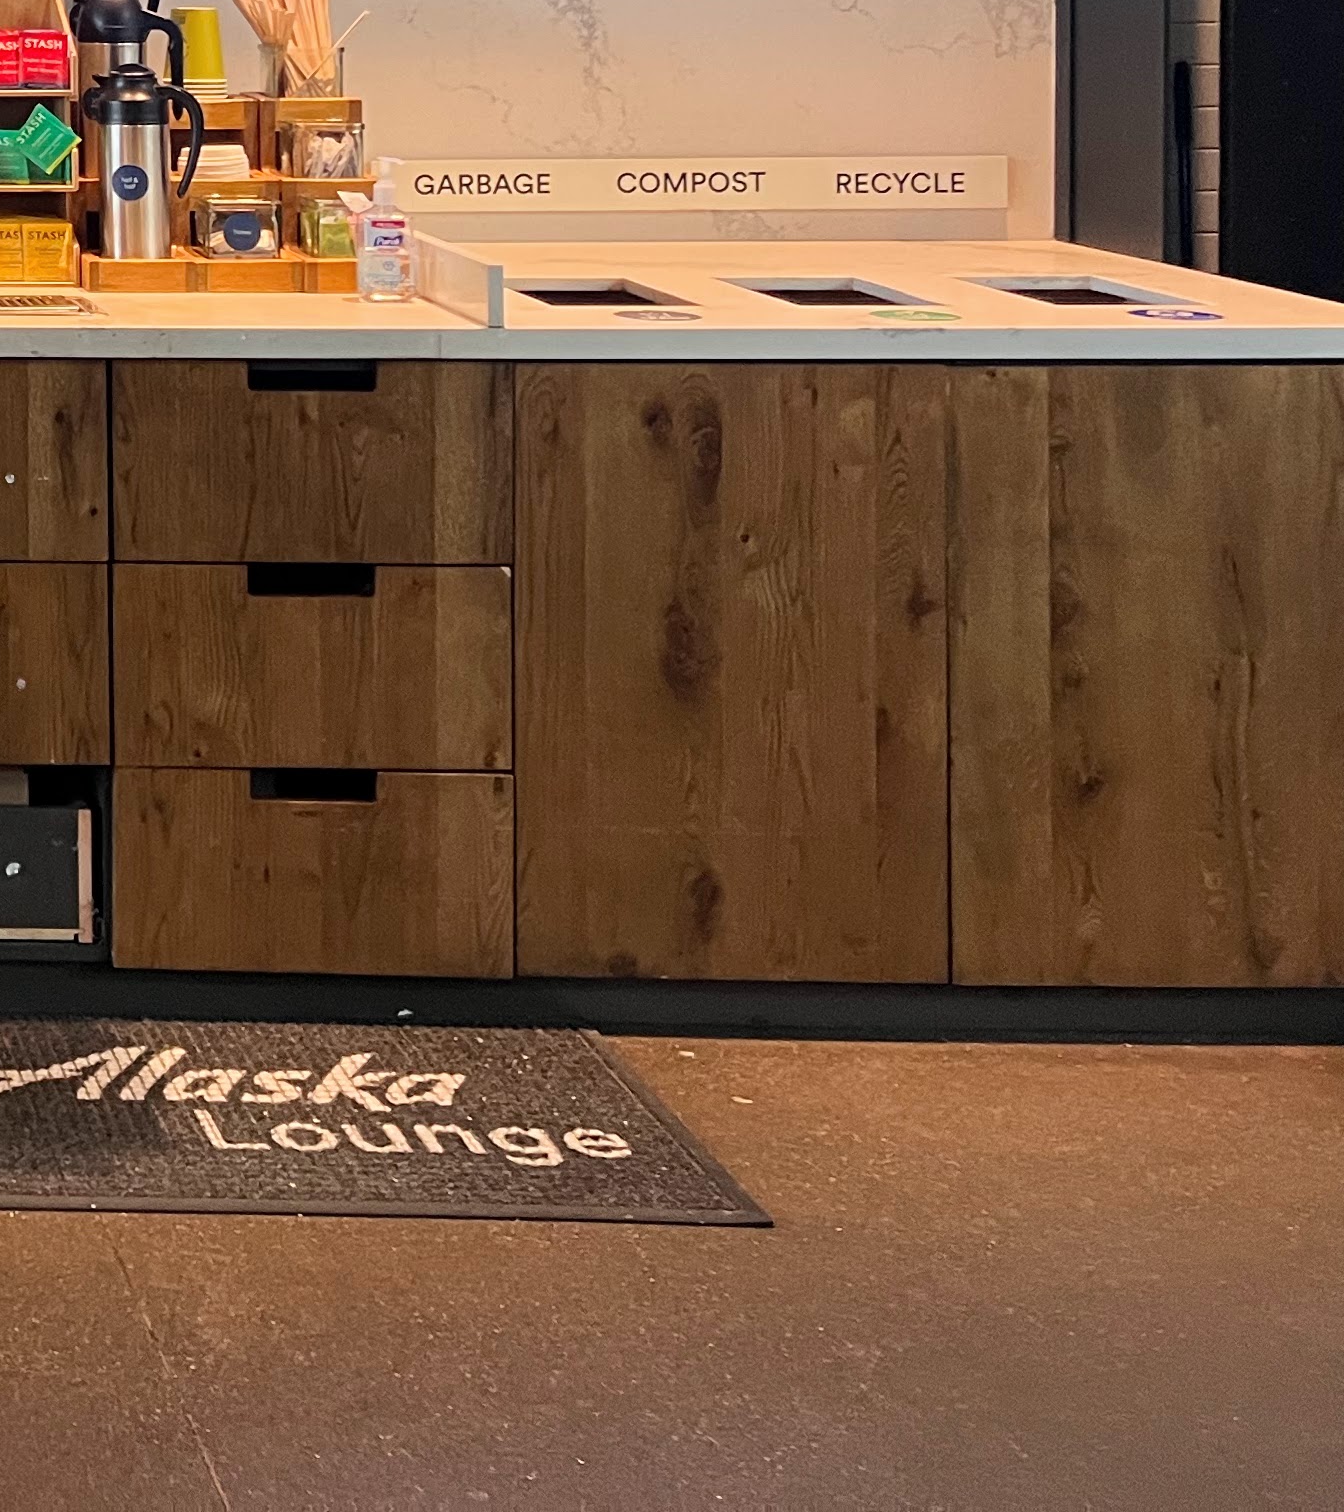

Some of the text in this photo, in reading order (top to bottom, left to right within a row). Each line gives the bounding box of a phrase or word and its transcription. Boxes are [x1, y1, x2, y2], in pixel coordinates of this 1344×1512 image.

[24, 38, 63, 50] STASH
[16, 111, 47, 145] STASH
[413, 171, 966, 196] GARBAGE COMPOST RECYCLE
[28, 230, 66, 240] STASH
[193, 1108, 632, 1168] Lounge
